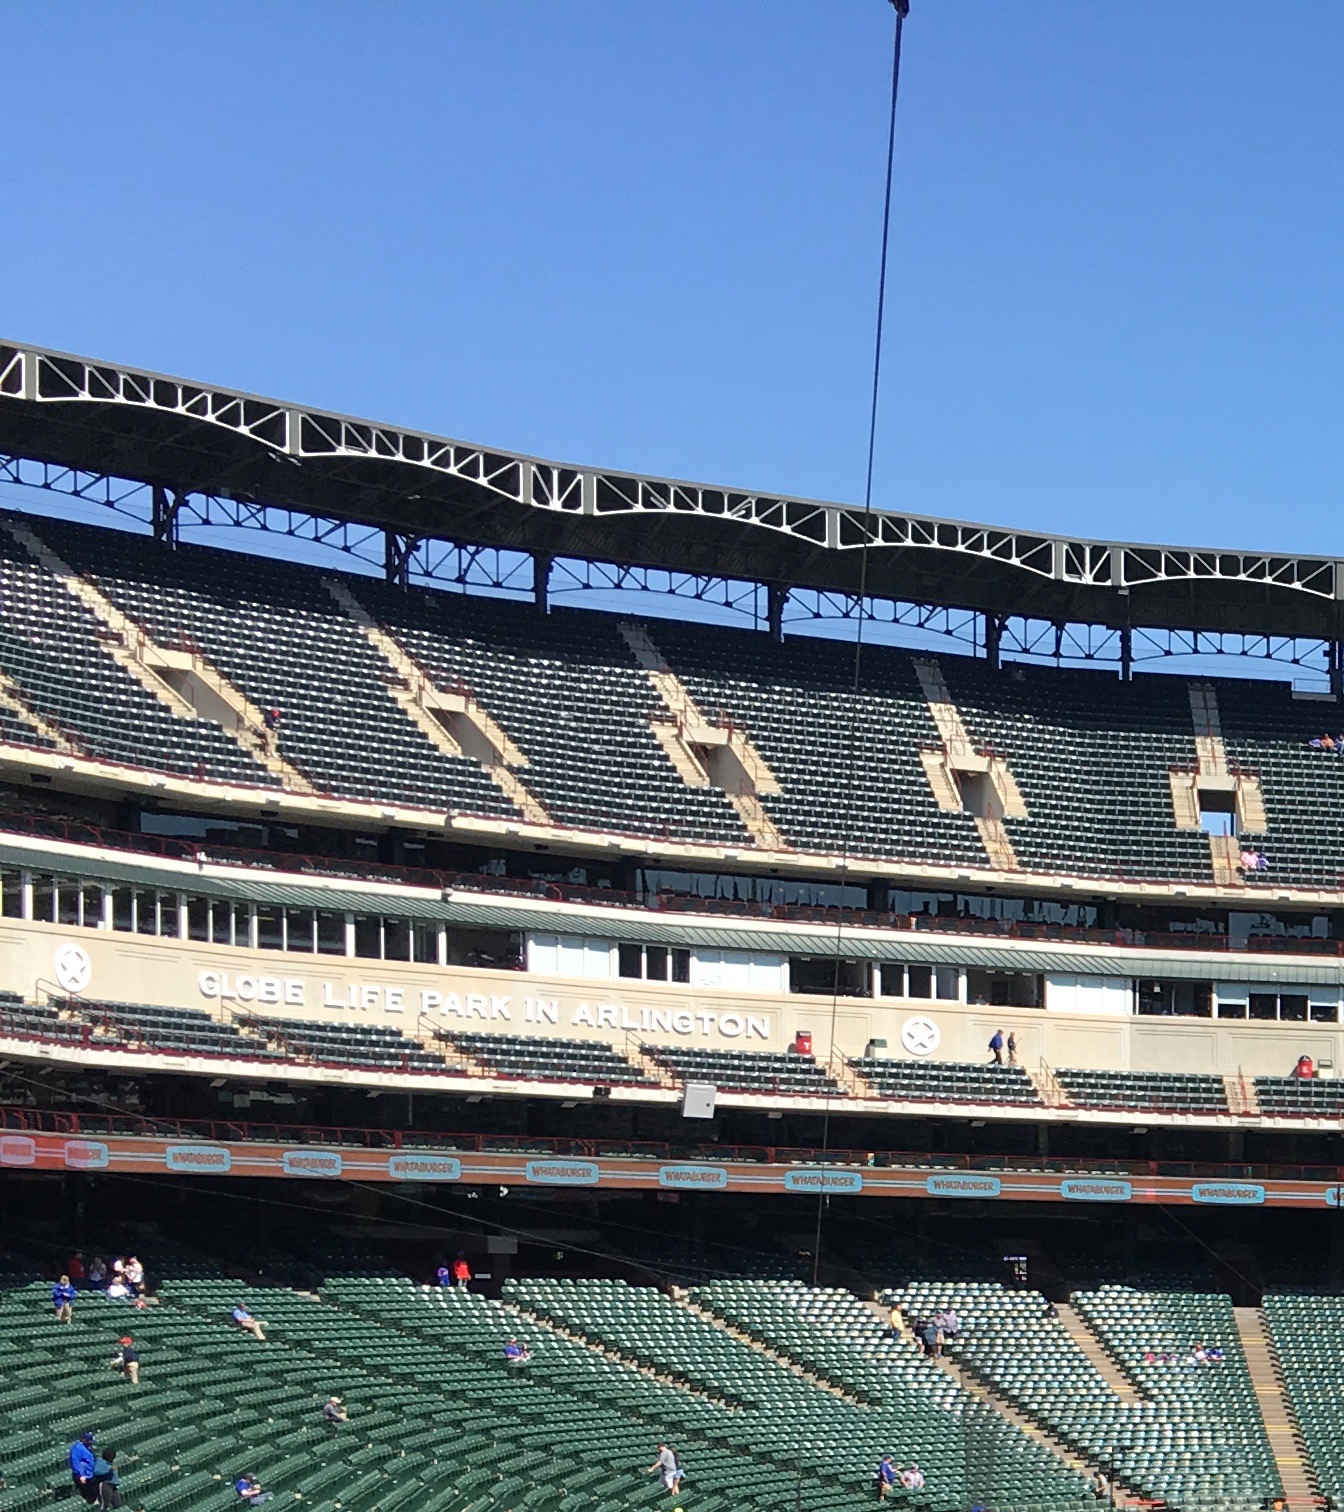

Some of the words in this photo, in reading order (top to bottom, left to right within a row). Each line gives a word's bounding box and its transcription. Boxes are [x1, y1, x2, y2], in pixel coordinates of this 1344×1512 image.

[199, 971, 305, 1006] GLOBE
[323, 981, 405, 1013] LIFE
[420, 989, 513, 1022] PARK
[524, 998, 558, 1024] IN
[571, 1002, 770, 1039] ARLINGTON
[532, 1166, 593, 1179] WHATABURGER
[792, 1175, 855, 1187] WHATABURGER
[933, 1179, 995, 1191] WHATABURGER
[1067, 1183, 1126, 1194] WHATABURGER
[1199, 1188, 1259, 1199] WHATABURGER
